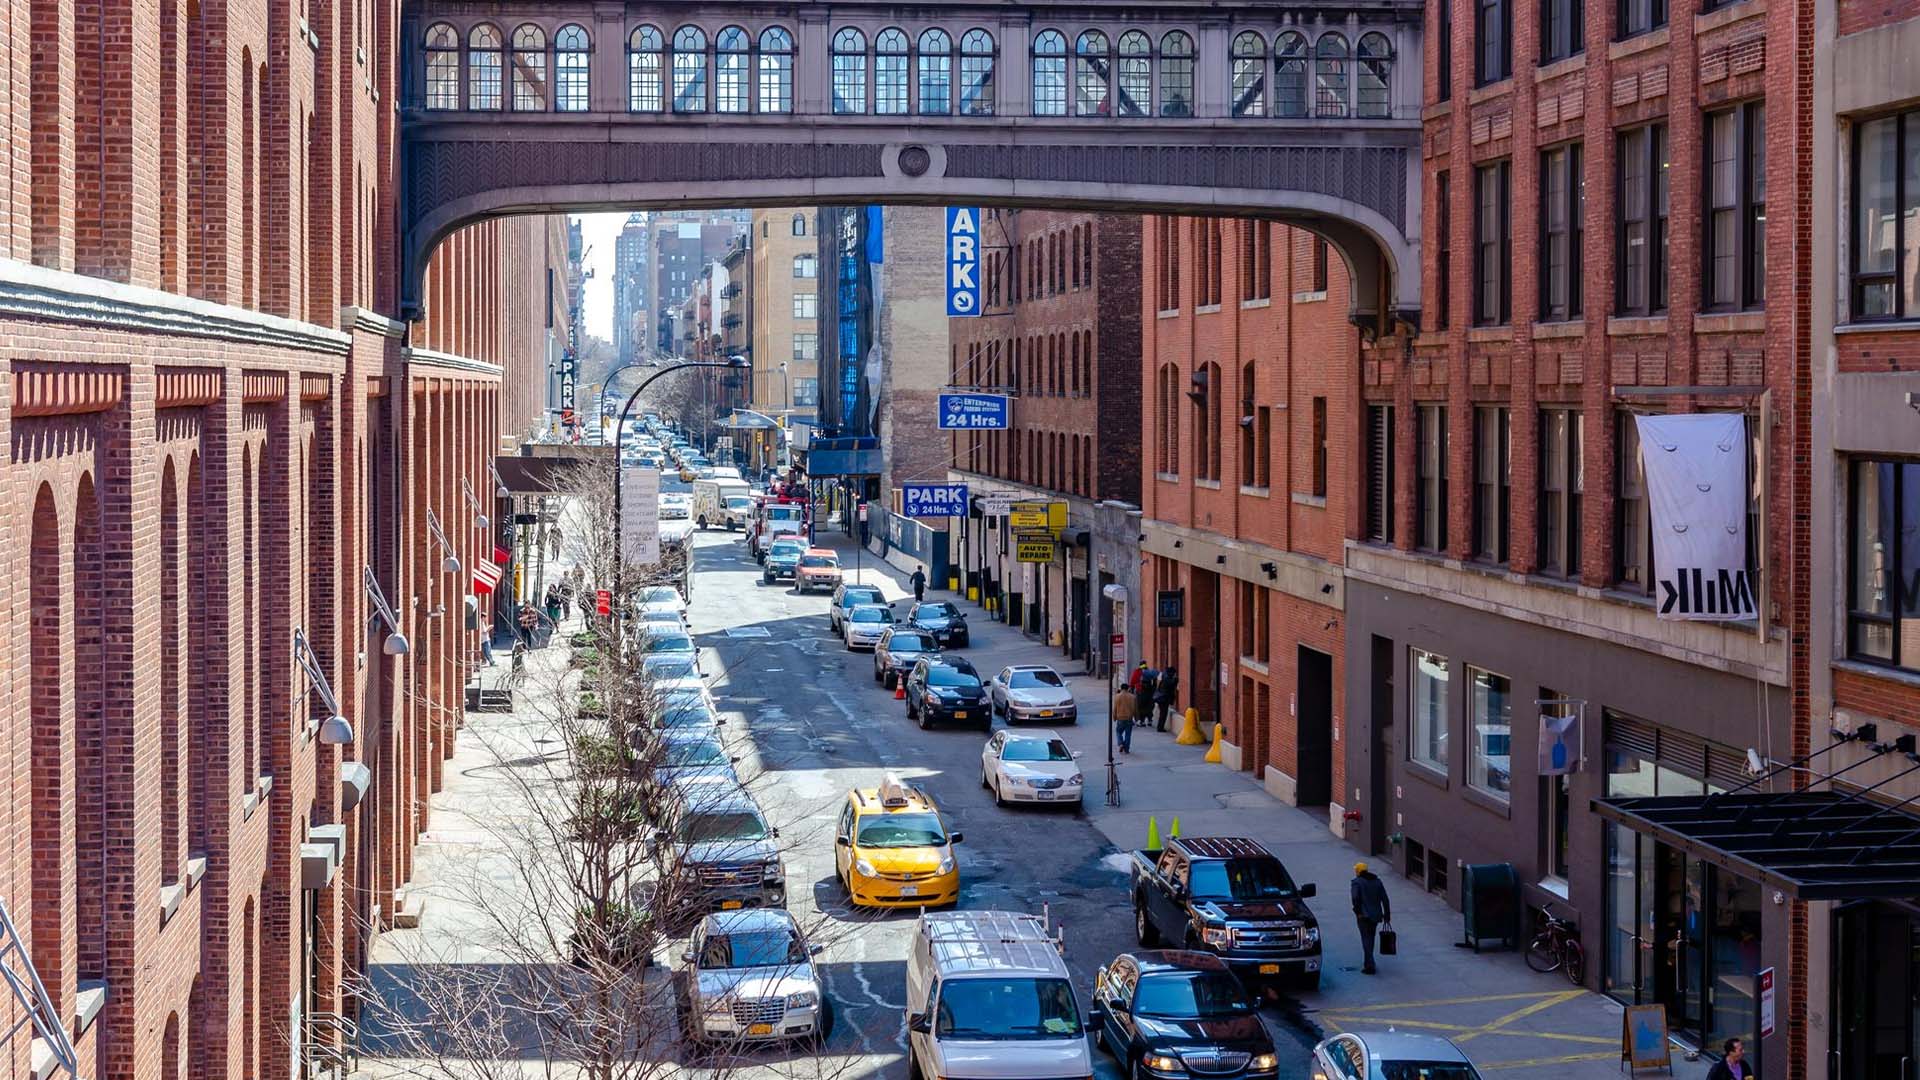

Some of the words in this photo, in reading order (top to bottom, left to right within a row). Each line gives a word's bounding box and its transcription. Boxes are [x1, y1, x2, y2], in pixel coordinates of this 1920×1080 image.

[563, 362, 573, 408] PARK
[946, 414, 967, 426] 24
[971, 414, 1001, 426] Hrs.
[907, 487, 963, 504] PARK
[922, 506, 933, 514] 24
[934, 506, 949, 514] Hrs.
